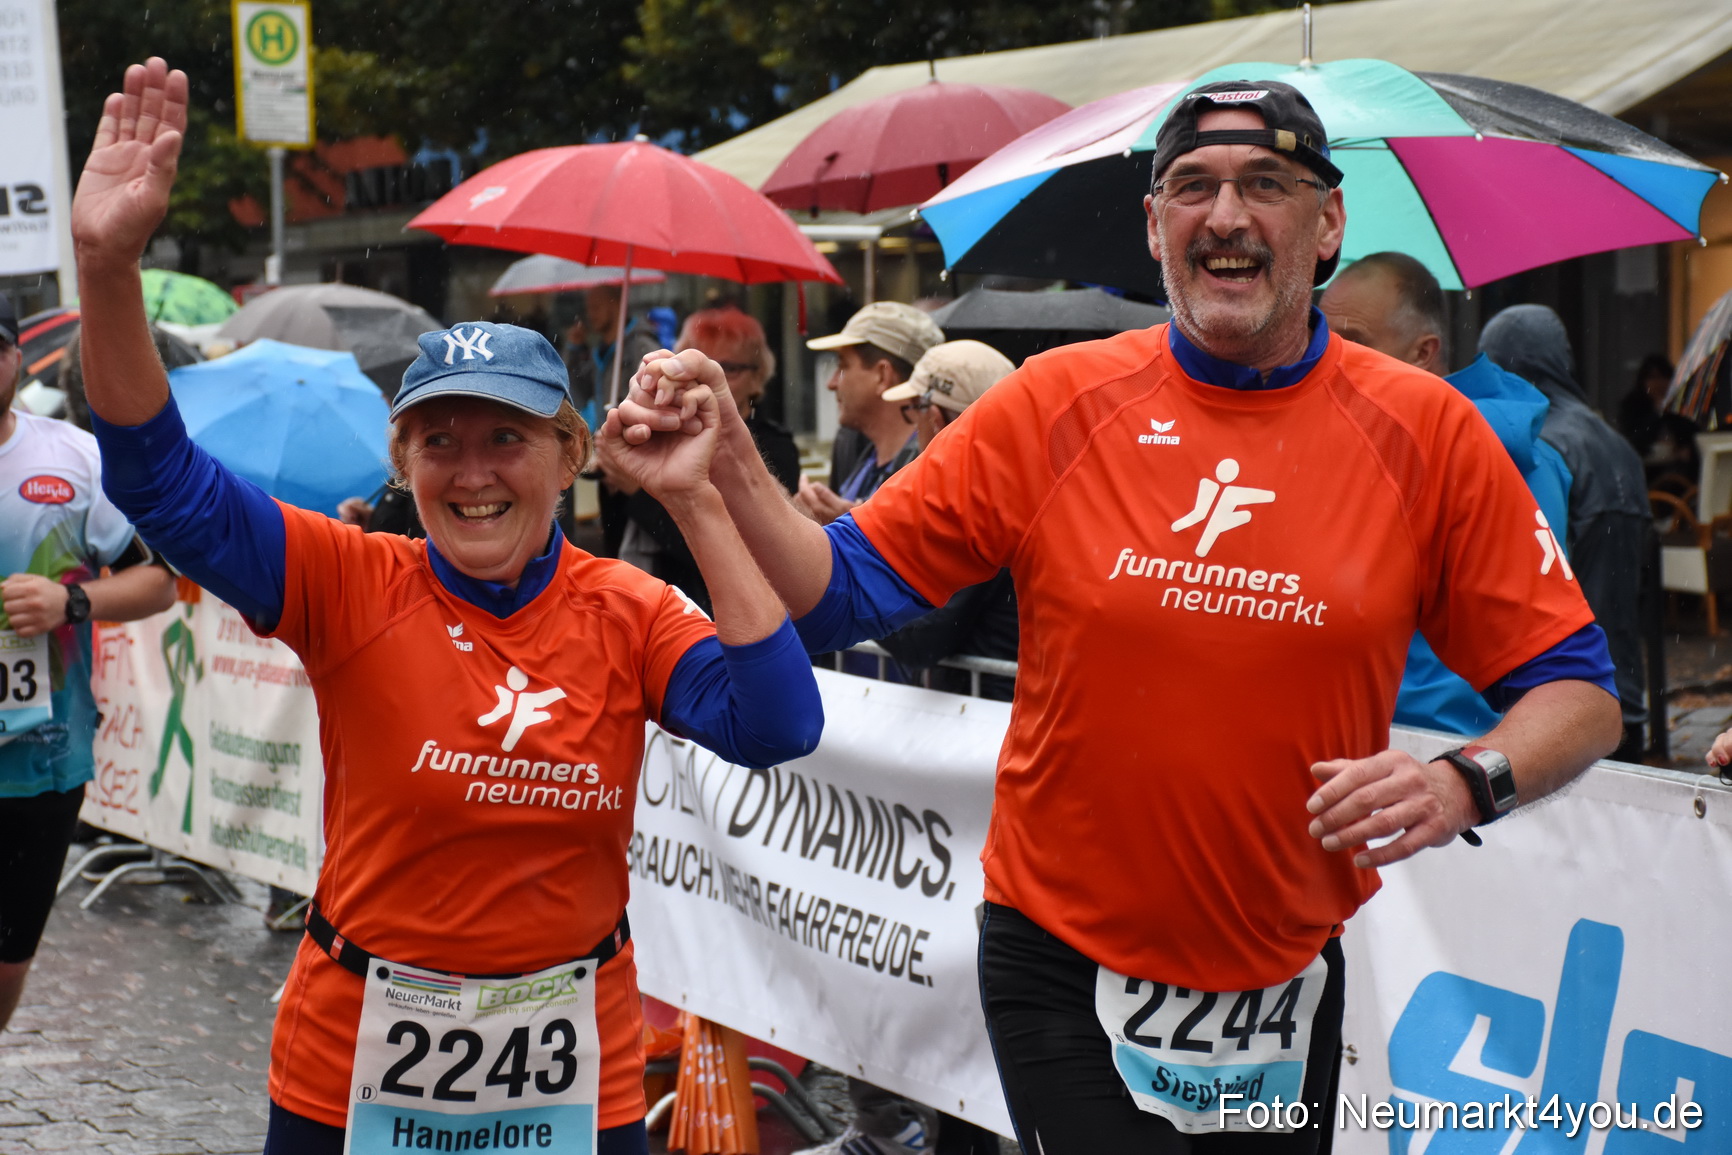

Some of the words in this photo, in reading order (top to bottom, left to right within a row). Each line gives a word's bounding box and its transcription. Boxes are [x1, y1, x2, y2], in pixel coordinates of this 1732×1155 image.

[259, 24, 285, 53] H
[1209, 90, 1261, 101] Castrol
[1138, 433, 1181, 445] erima
[1108, 547, 1301, 595] funrunners
[1159, 587, 1328, 626] neumarkt
[411, 740, 600, 785] funrunners
[464, 780, 623, 811] neumarkt
[727, 766, 956, 901] DYNAMICS.
[766, 881, 934, 988] FAHRFREUDE.
[385, 987, 462, 1011] NeuerMarkt
[477, 971, 577, 1010] BOCK
[509, 1006, 519, 1015] by
[545, 997, 579, 1009] concepts
[1123, 976, 1305, 1054] 2244
[380, 1018, 578, 1102] 2243
[361, 1086, 373, 1100] D
[1151, 1065, 1265, 1111] Siegfried
[391, 1117, 552, 1152] Hannelore
